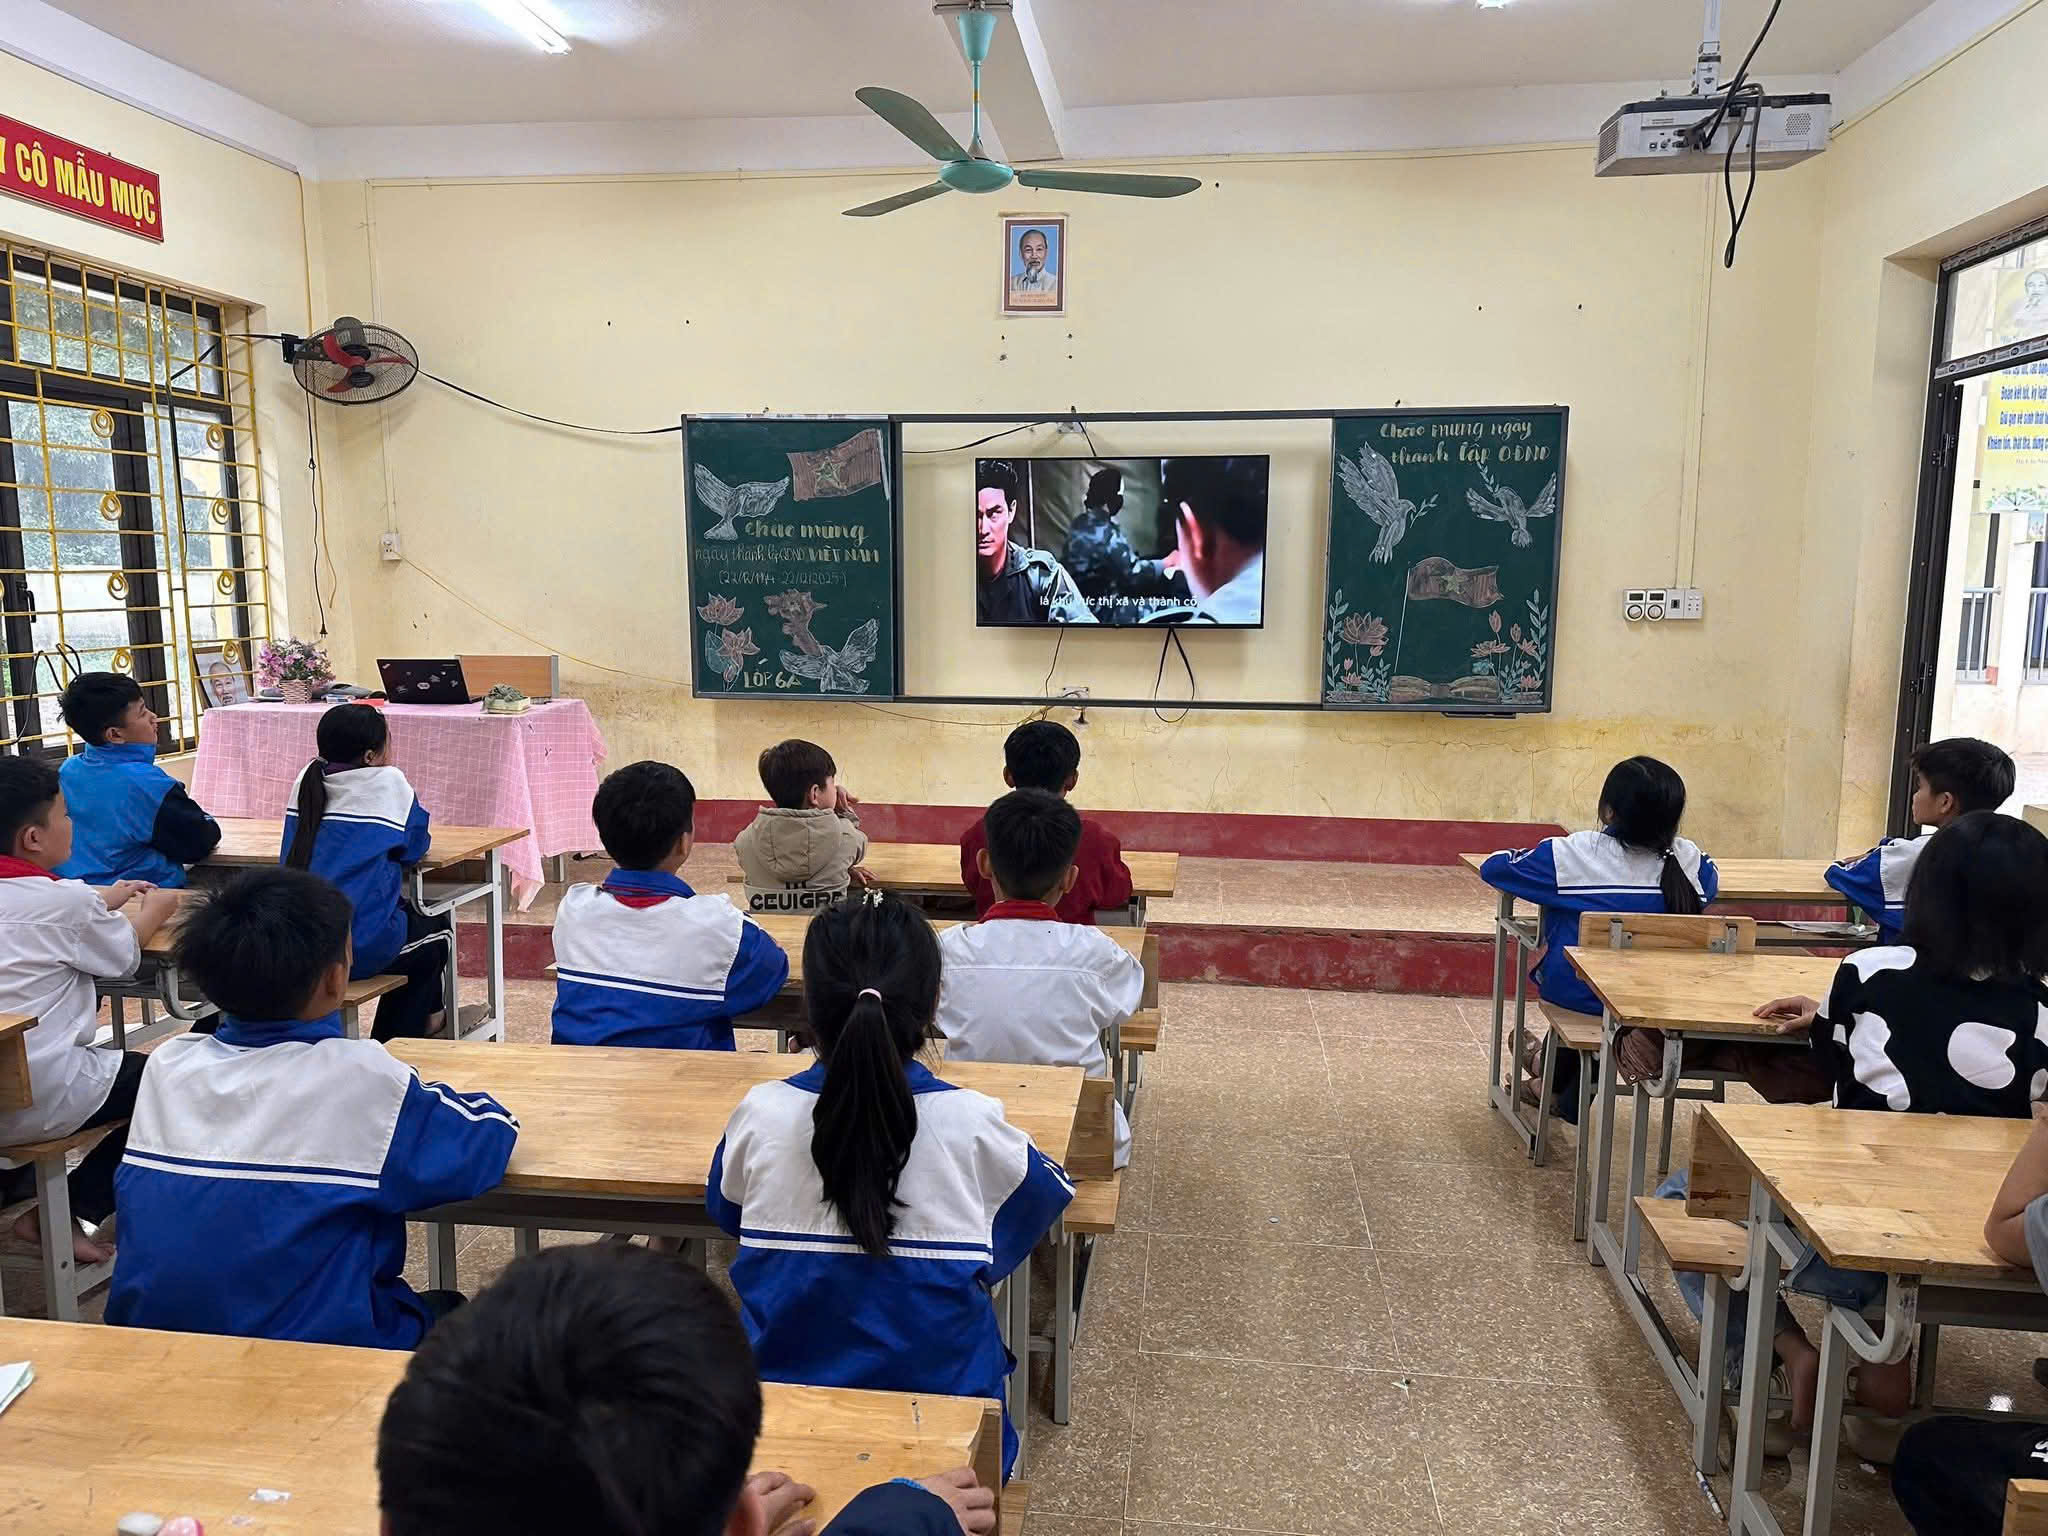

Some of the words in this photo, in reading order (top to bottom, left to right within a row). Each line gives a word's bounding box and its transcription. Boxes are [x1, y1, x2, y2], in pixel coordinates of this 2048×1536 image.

[15, 141, 48, 188] CÔ
[53, 151, 105, 207] MẪU
[109, 176, 156, 227] MỰC
[1098, 595, 1113, 609] thị
[1115, 596, 1129, 606] xã
[1132, 596, 1145, 606] và
[1148, 596, 1181, 607] thành
